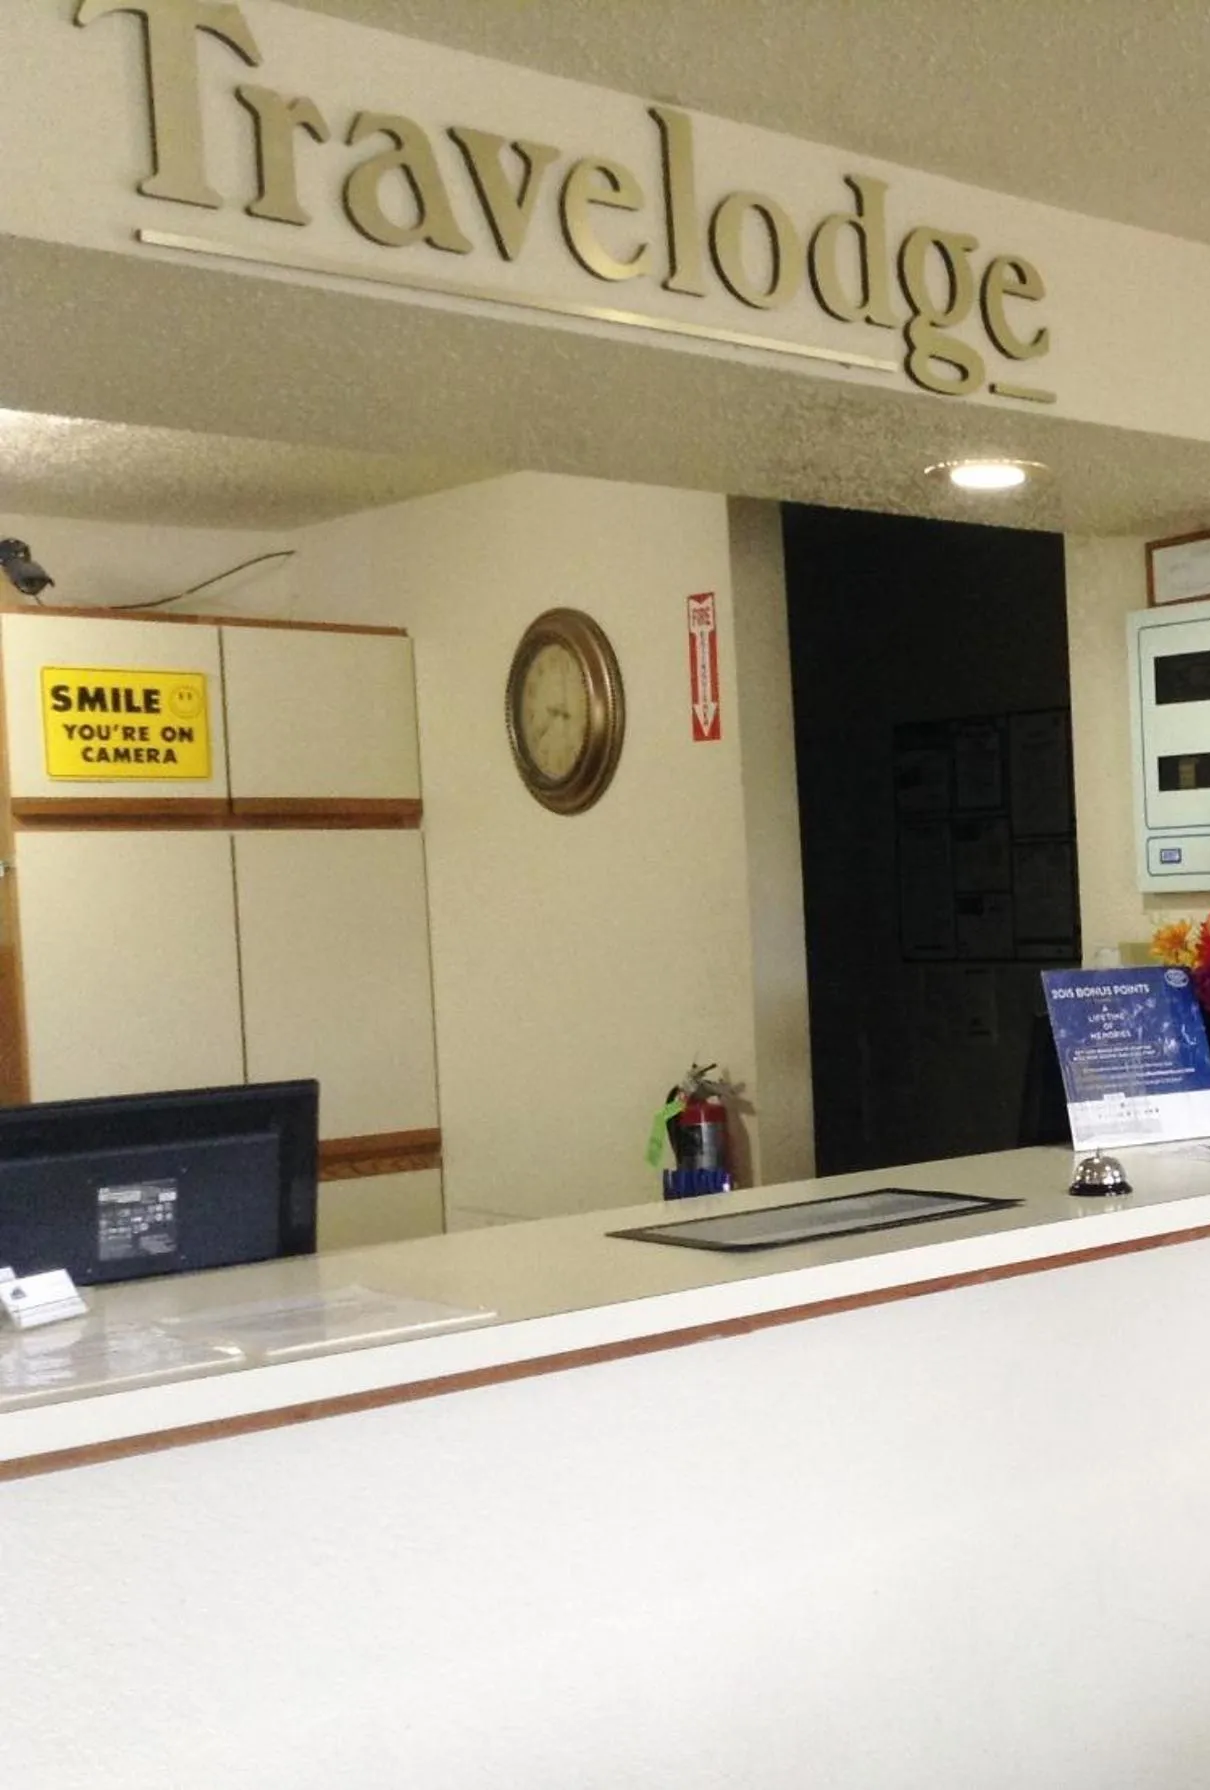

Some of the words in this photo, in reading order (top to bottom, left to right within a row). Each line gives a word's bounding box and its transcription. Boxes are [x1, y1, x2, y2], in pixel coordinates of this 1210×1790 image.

[72, 0, 1051, 396] Travelodge
[51, 685, 161, 714] SMILE
[63, 724, 149, 742] YOU'RE
[160, 726, 194, 743] ON
[81, 746, 178, 764] CAMERA
[1076, 985, 1112, 998] BONUS
[1114, 983, 1150, 996] POINTS
